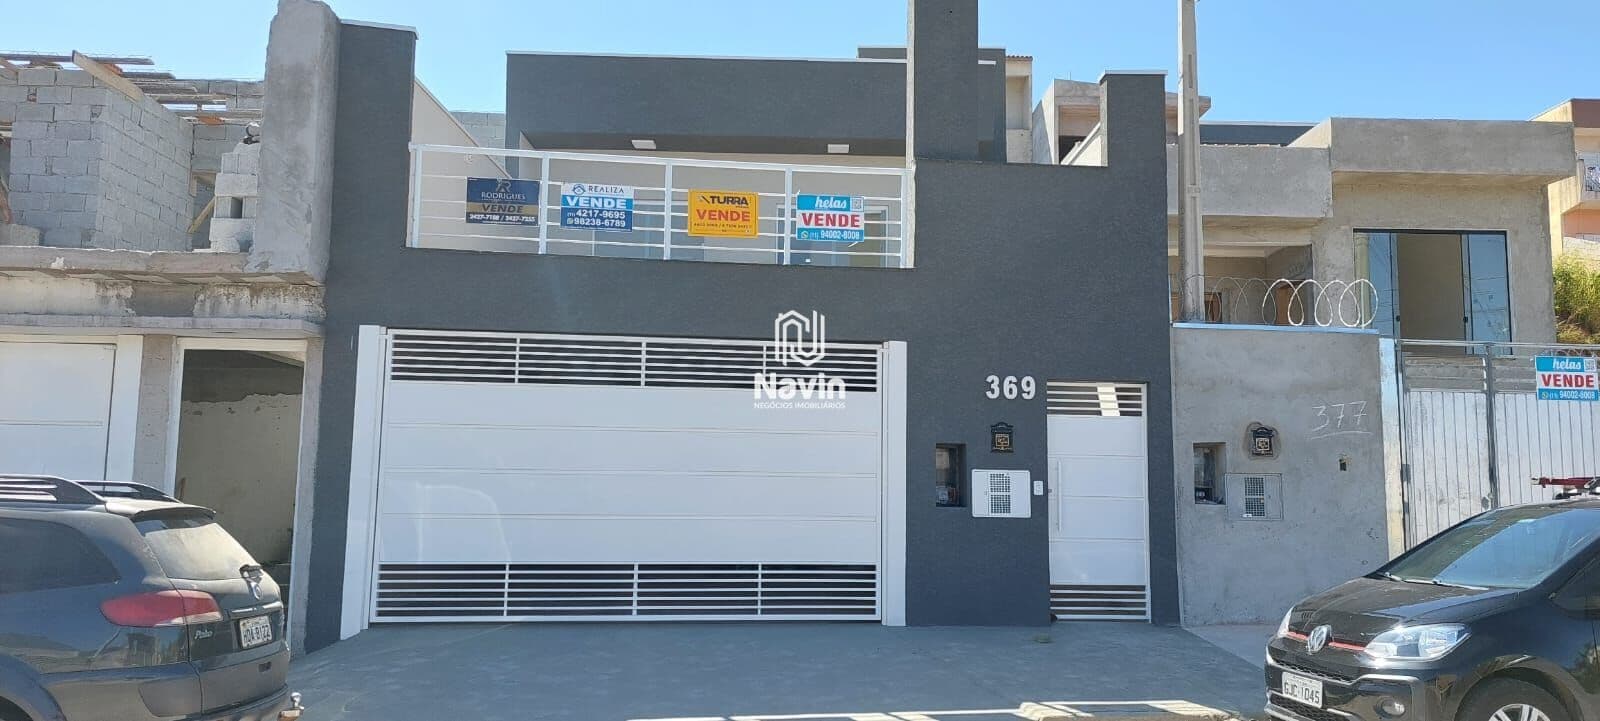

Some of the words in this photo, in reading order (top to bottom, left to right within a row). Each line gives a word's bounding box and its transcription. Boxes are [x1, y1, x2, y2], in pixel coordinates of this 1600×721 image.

[588, 185, 624, 193] REALIZA
[481, 192, 525, 200] RODRIGUES
[710, 195, 749, 206] TURRA
[815, 196, 847, 208] helas
[482, 203, 524, 213] VENDE
[566, 196, 627, 209] VENDE
[576, 209, 626, 219] 4217-9695
[696, 208, 751, 222] VENDE
[801, 212, 860, 227] VENDE
[1552, 358, 1582, 370] helas
[1541, 373, 1595, 388] VENDE
[985, 375, 1036, 400] 369
[1311, 400, 1368, 432] 377
